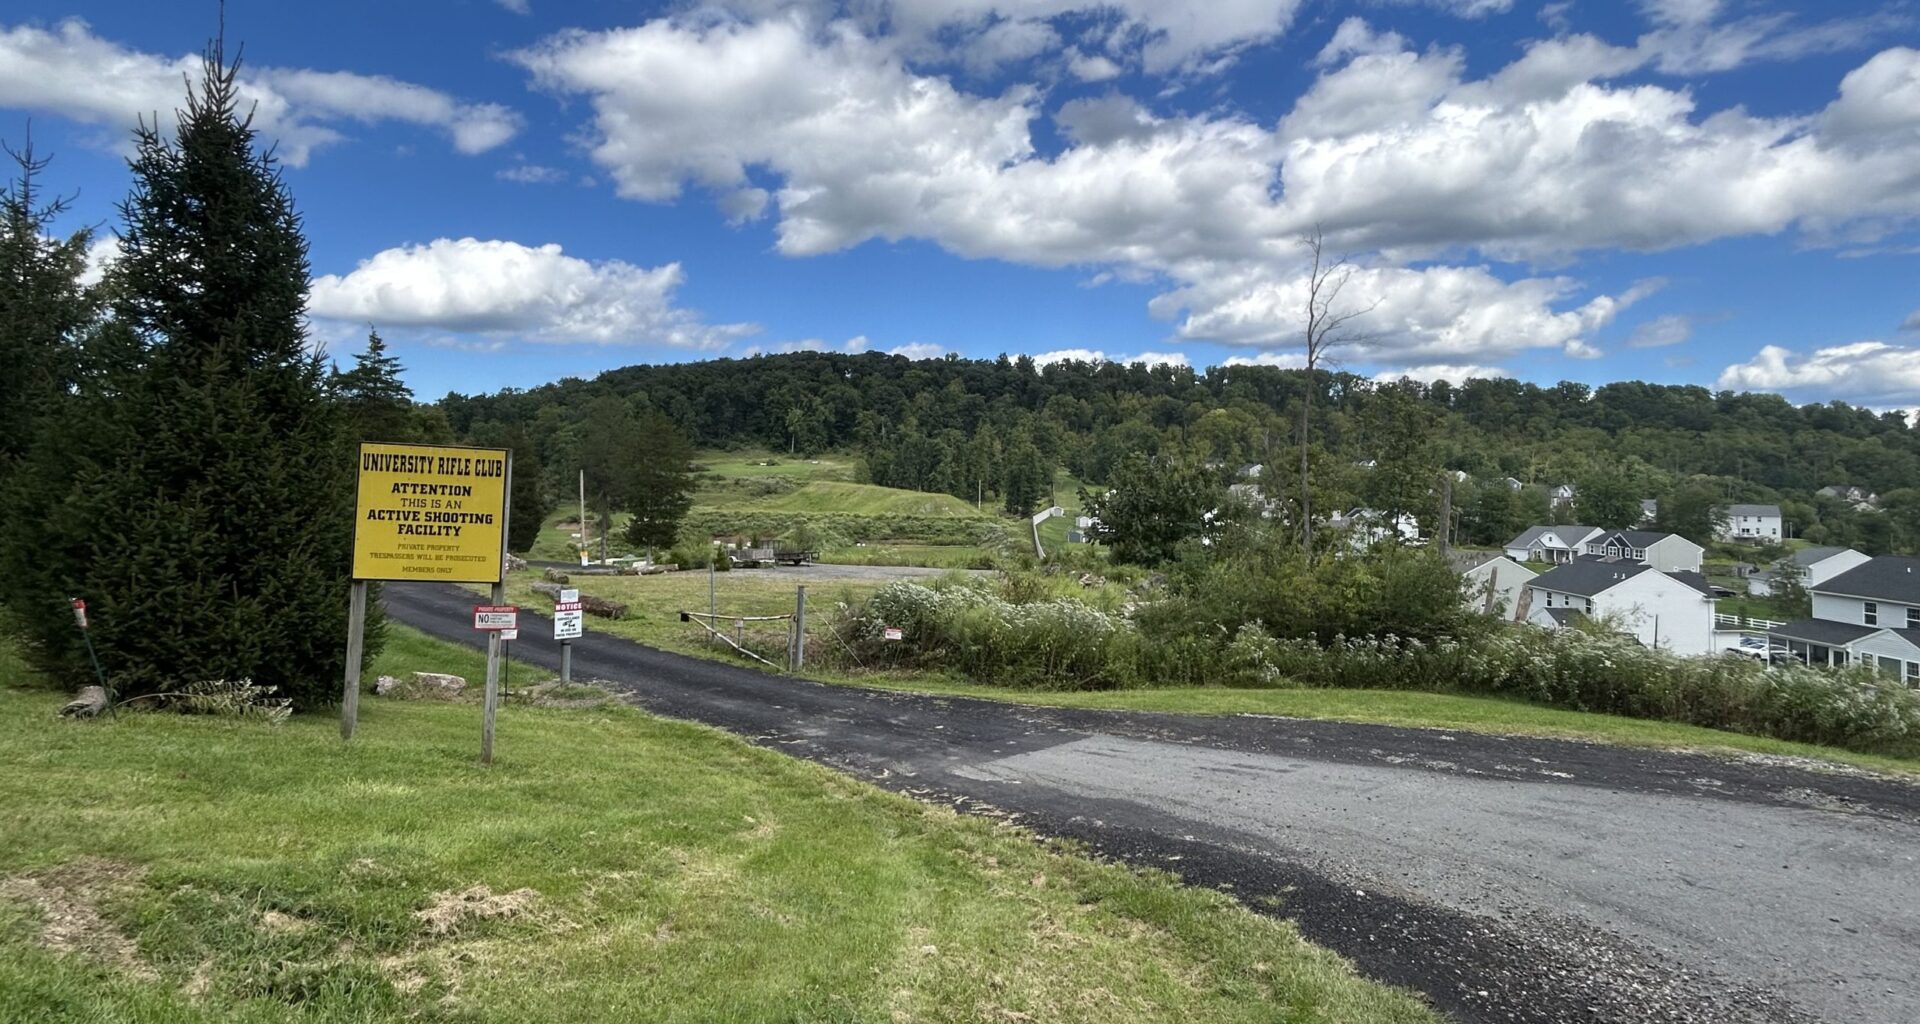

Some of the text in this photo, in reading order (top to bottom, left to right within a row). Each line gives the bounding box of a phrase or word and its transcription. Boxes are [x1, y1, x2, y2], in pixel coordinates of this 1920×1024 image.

[363, 453, 502, 477] UNIVERSITY RIFLE CLUB
[392, 482, 472, 497] ATTENTION
[401, 498, 462, 510] THIS IS AN
[367, 509, 493, 524] ACTIVE SHOOTING
[398, 523, 462, 537] FACILITY
[398, 543, 460, 552] PRIVATE PROPERTY
[370, 552, 415, 560] TRESPASSERS
[417, 553, 432, 561] WILL
[445, 554, 486, 562] PROSECUTED
[402, 566, 435, 574] MEMBERS
[555, 602, 582, 610] NOTICE
[478, 614, 490, 624] NO
